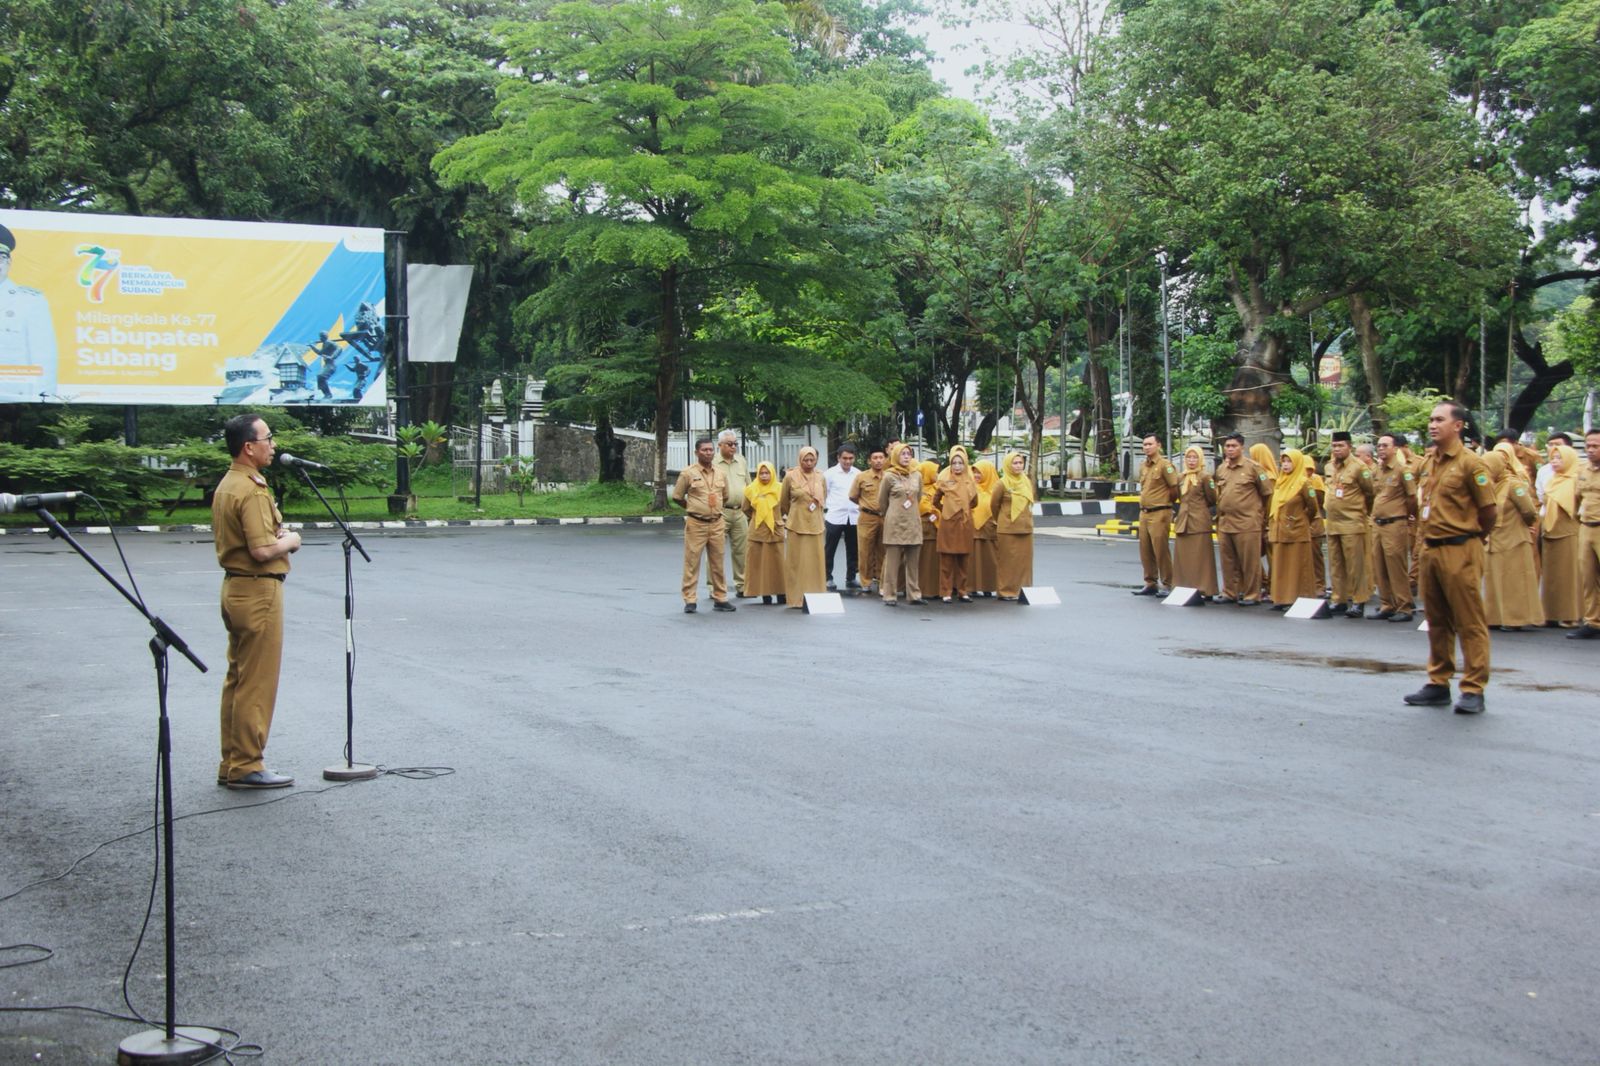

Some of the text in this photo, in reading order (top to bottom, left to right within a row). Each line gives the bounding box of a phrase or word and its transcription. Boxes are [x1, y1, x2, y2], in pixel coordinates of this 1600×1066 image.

[76, 311, 217, 327] Milangkala Ka-77
[76, 326, 218, 350] Kabupaten
[76, 347, 178, 372] Subang
